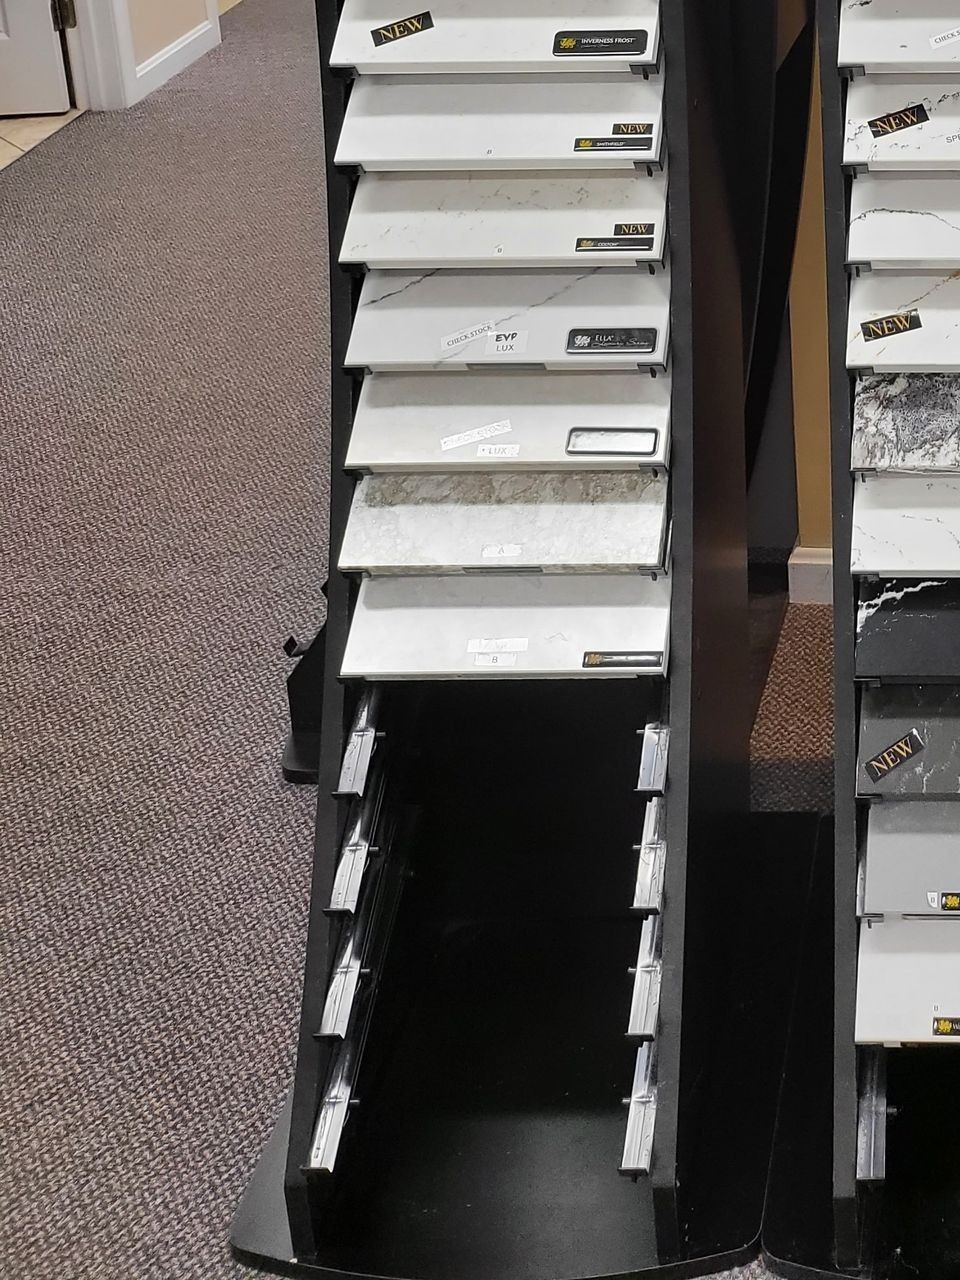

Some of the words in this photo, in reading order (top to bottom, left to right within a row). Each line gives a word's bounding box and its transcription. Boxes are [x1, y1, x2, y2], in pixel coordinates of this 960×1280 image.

[378, 17, 426, 43] NEW
[933, 30, 957, 45] CHECK
[618, 124, 648, 134] NEW
[875, 108, 919, 135] NEW
[621, 224, 649, 234] NEW
[867, 315, 912, 338] NEW
[446, 332, 469, 347] CHECK
[470, 324, 493, 338] STOCK
[495, 332, 518, 342] EVP
[496, 343, 515, 352] LUX
[488, 447, 507, 455] LUX
[870, 736, 915, 776] NEW
